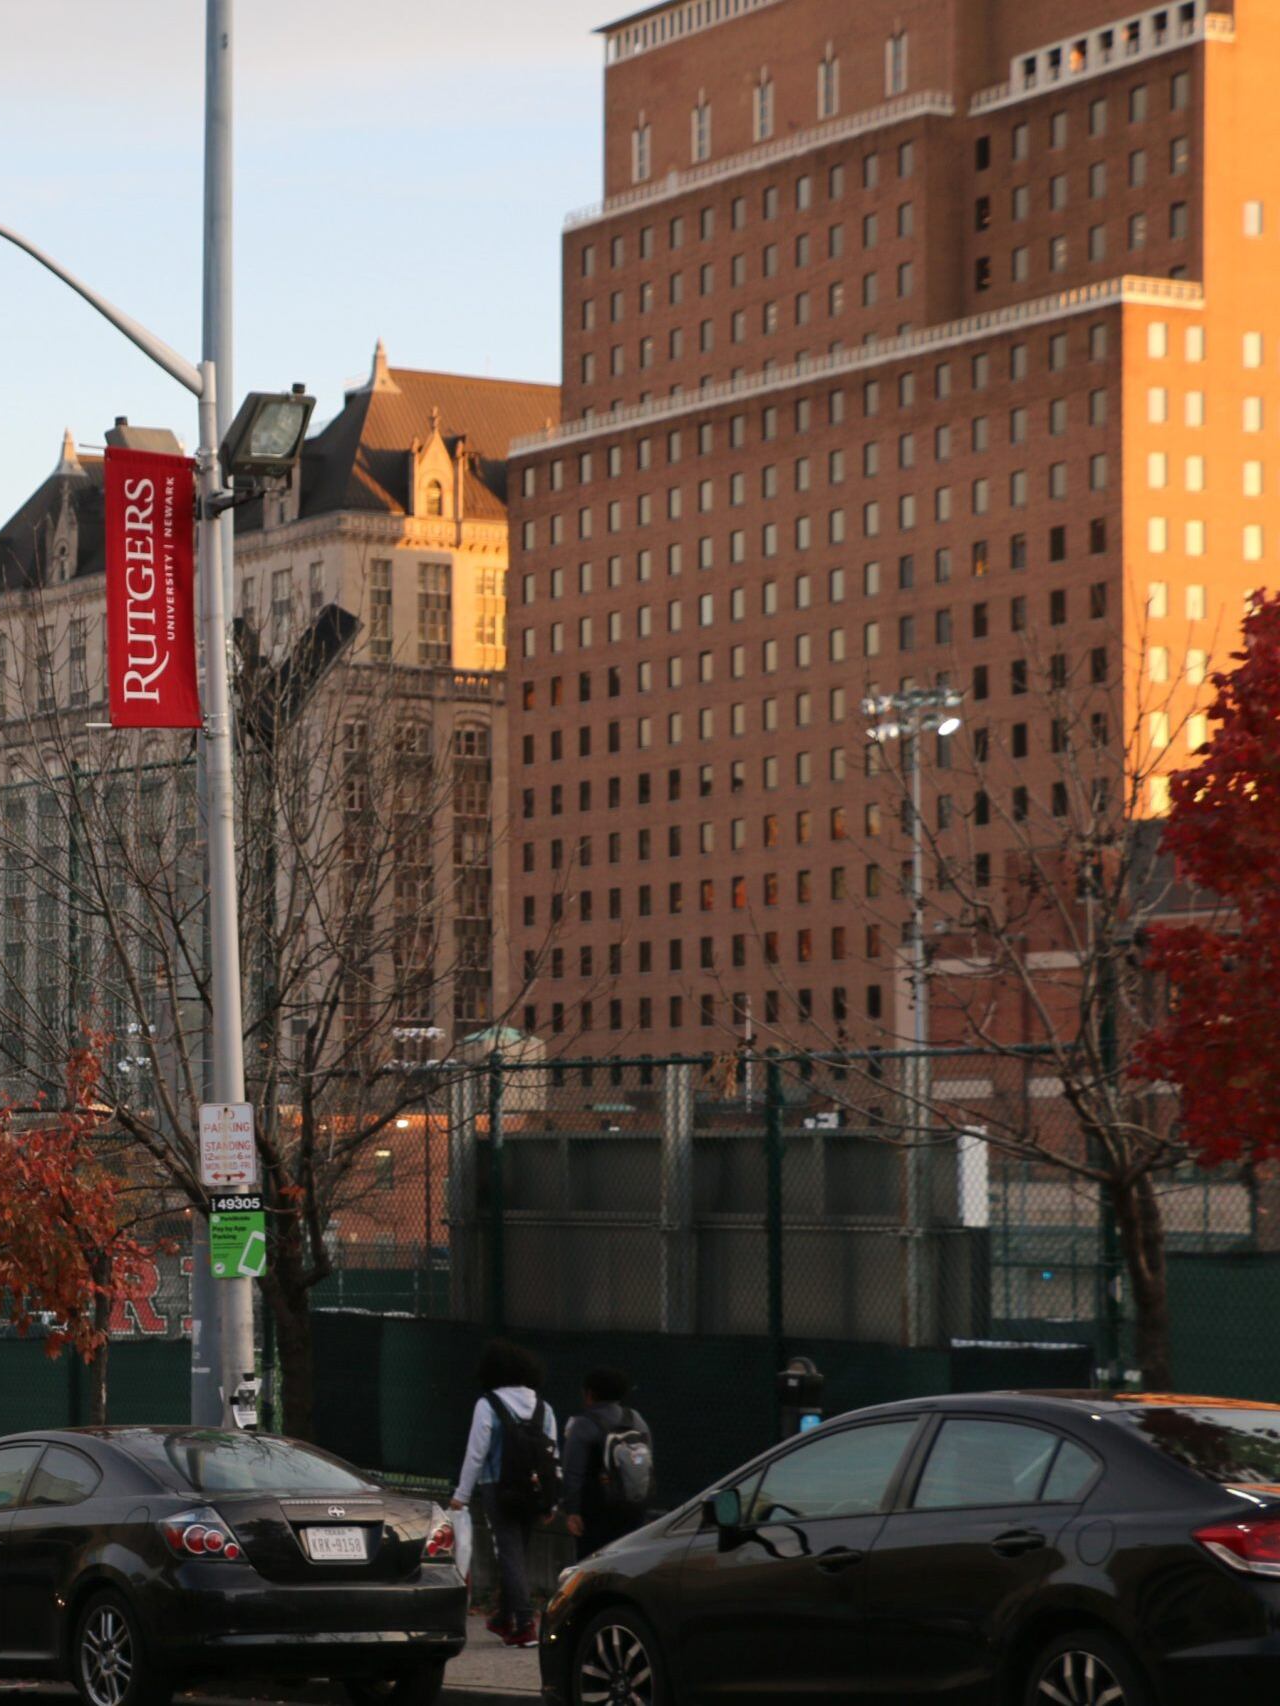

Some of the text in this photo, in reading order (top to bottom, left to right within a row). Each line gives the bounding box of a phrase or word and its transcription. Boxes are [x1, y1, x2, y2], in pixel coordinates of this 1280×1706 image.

[123, 478, 169, 703] RUTGERS
[163, 476, 176, 641] UNIVERSITY NEWARK
[205, 1141, 252, 1152] STANDING
[218, 1197, 260, 1210] 49305
